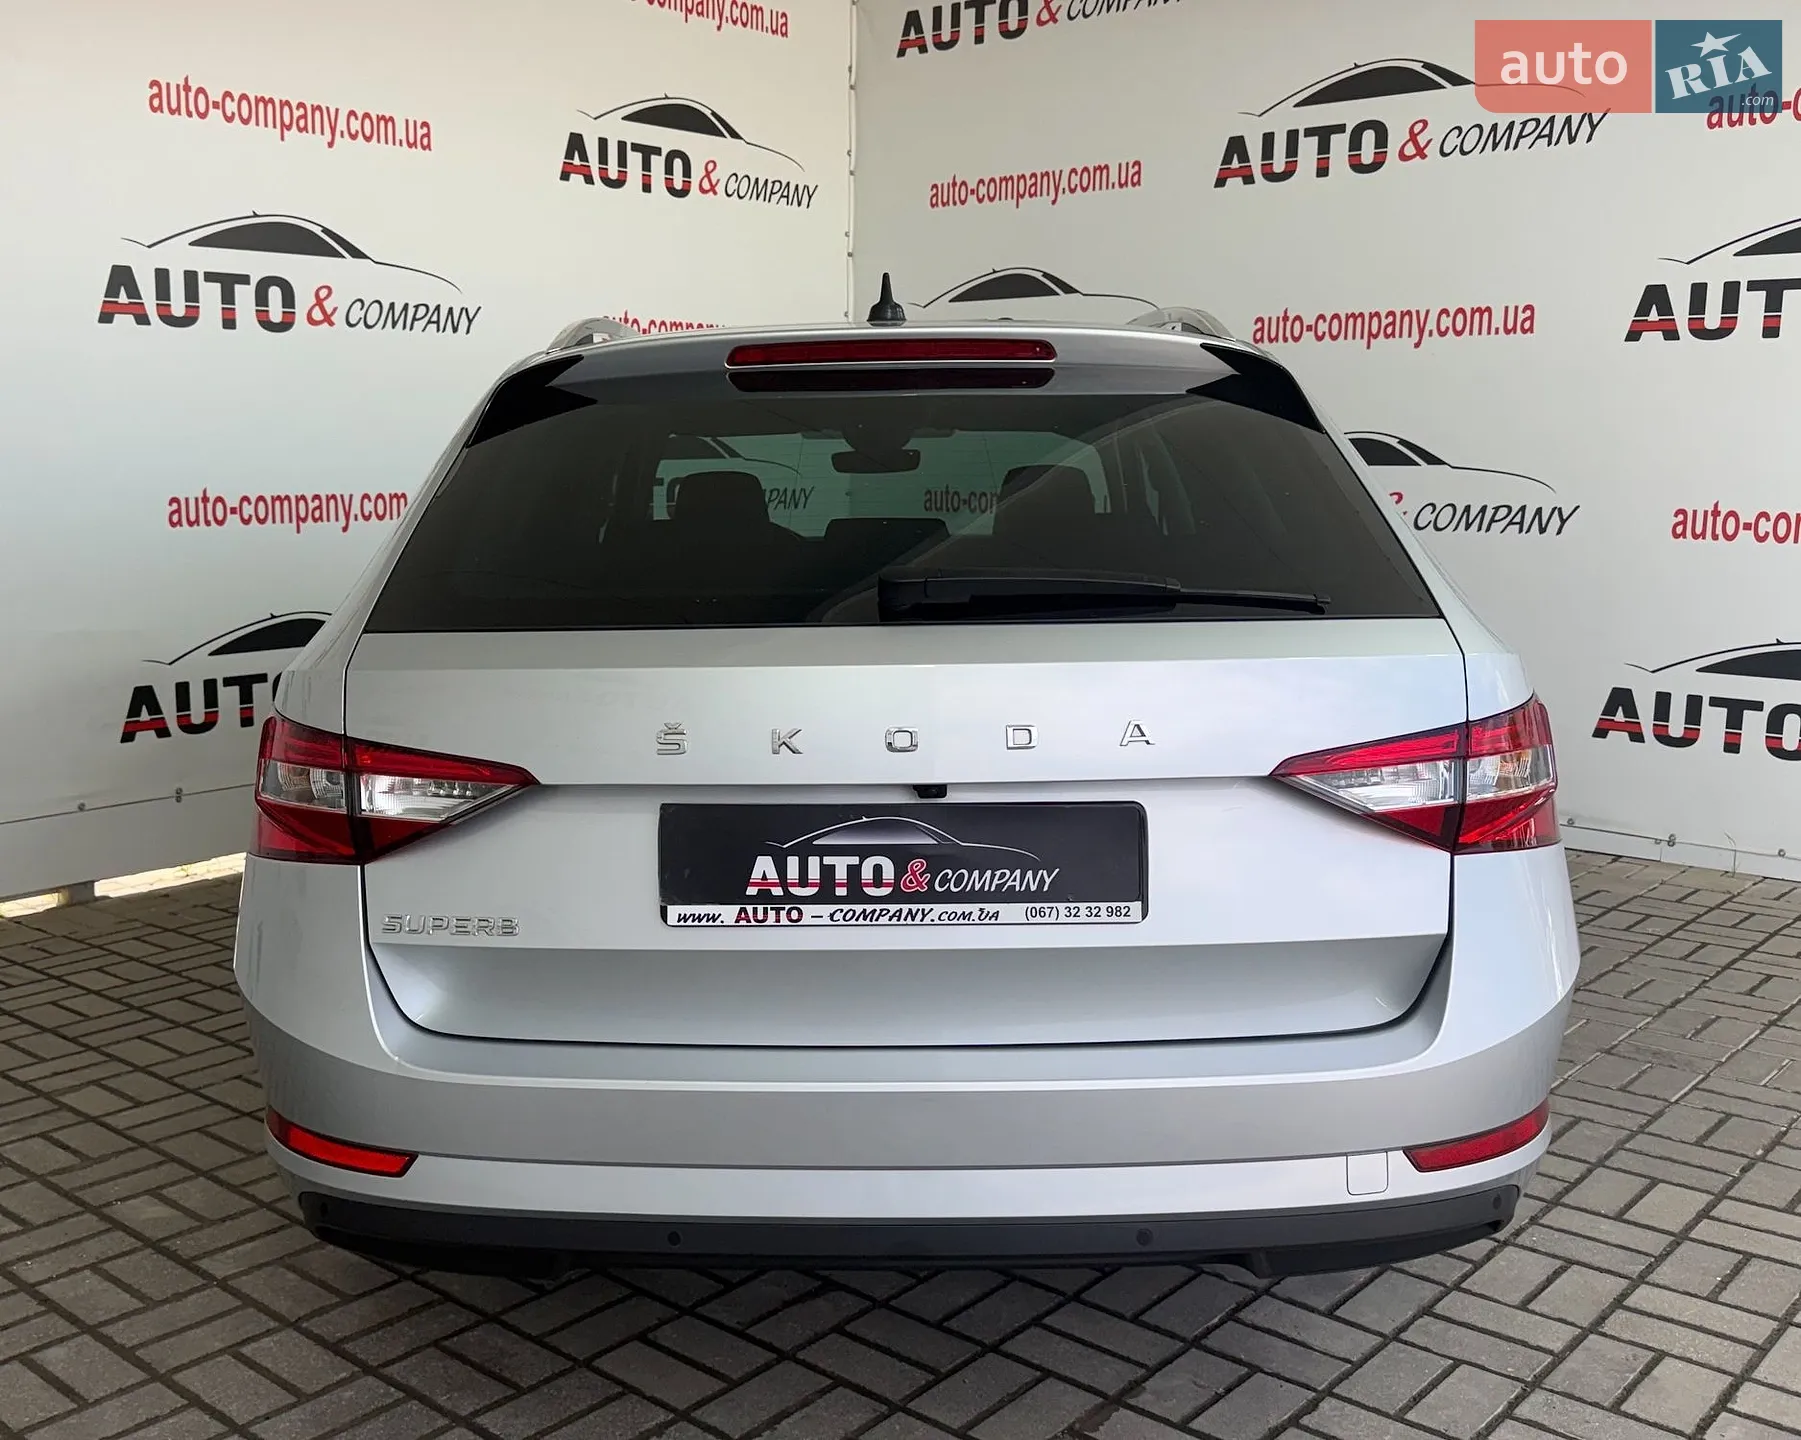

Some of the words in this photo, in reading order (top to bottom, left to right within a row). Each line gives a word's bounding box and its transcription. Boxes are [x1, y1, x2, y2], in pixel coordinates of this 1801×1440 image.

[896, 0, 1029, 58] AUTO
[148, 75, 432, 151] auto-company.com.ua
[559, 131, 692, 198] AUTO
[698, 159, 721, 196] &
[724, 172, 819, 209] COMPANY
[1213, 118, 1389, 188] AUTO
[1398, 118, 1433, 163] &
[1438, 107, 1612, 158] COMPANY
[929, 159, 1142, 209] auto-company.com.ua
[97, 264, 296, 333] AUTO
[306, 284, 337, 328] &
[345, 297, 482, 335] COMPANY
[1252, 303, 1536, 350] auto-company.com.ua
[1413, 502, 1581, 536] COMPANY
[120, 672, 282, 743] AUT
[1591, 687, 1801, 761] AUTO
[745, 855, 895, 897] AUTO
[900, 858, 929, 893] &
[933, 868, 1060, 892] COMPANY
[380, 913, 521, 938] SUPERB
[734, 906, 804, 924] AUTO
[1024, 905, 1060, 921] (067)
[1064, 905, 1081, 918] 32
[1085, 905, 1101, 918] 32
[1105, 904, 1131, 918] 982
